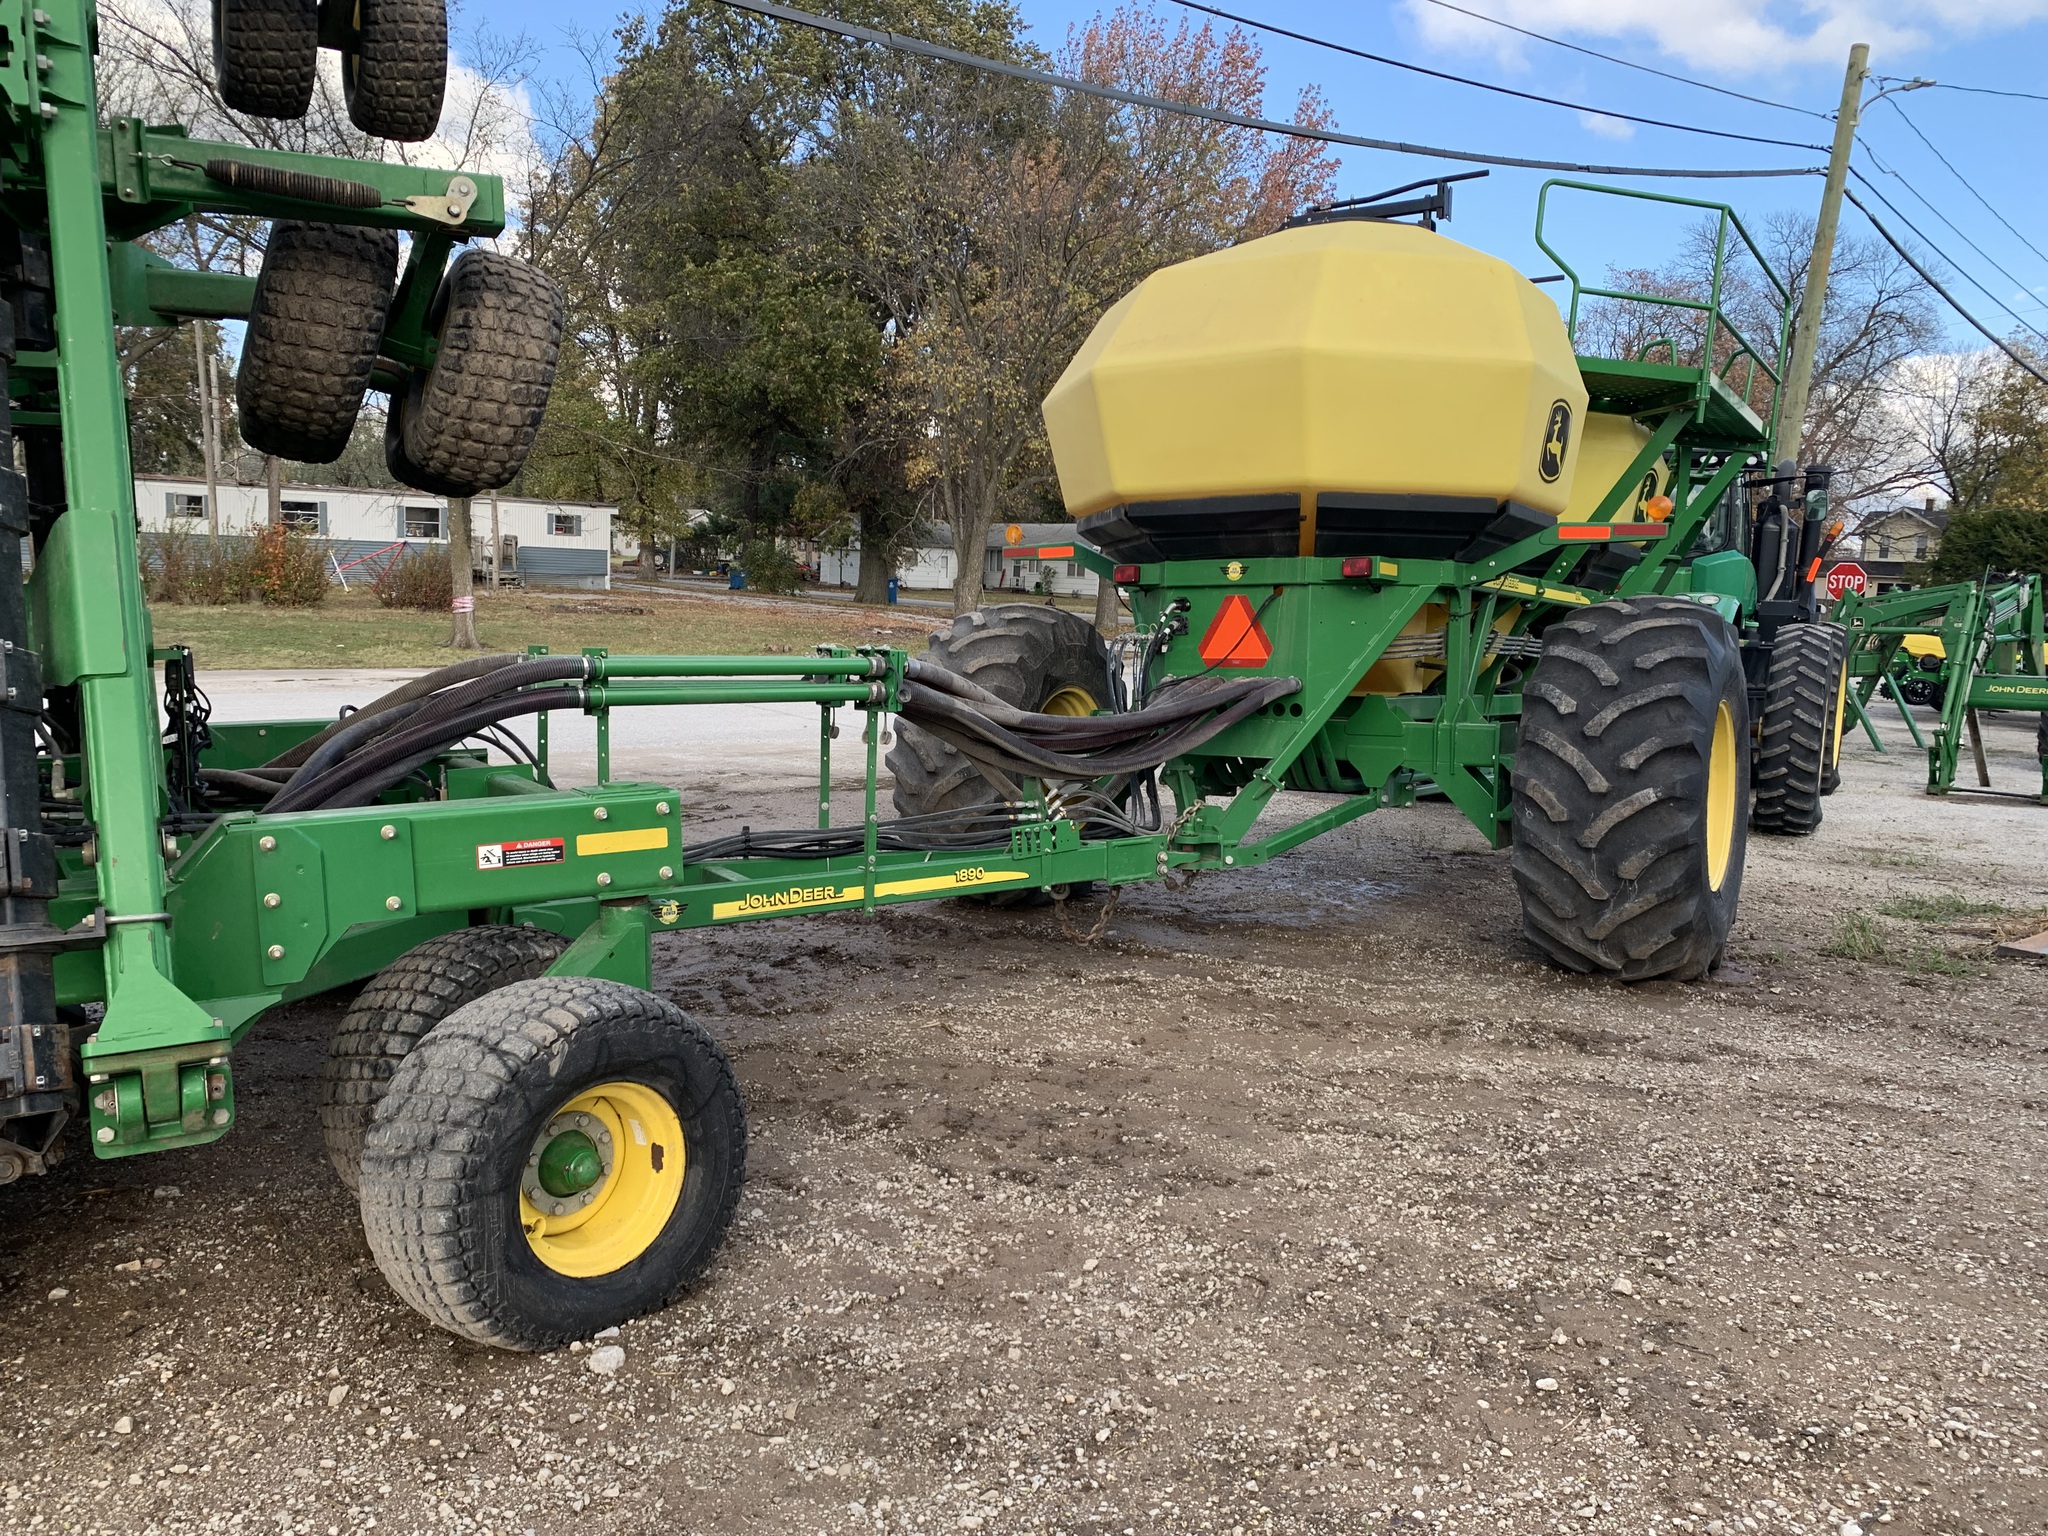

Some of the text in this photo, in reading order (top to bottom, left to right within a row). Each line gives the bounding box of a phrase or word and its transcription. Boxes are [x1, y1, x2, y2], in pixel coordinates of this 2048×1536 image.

[1829, 574, 1864, 590] STOP
[1985, 685, 2015, 693] JOHN
[523, 840, 551, 848] DANGER
[955, 866, 985, 882] 1890
[739, 891, 788, 910] JOHN
